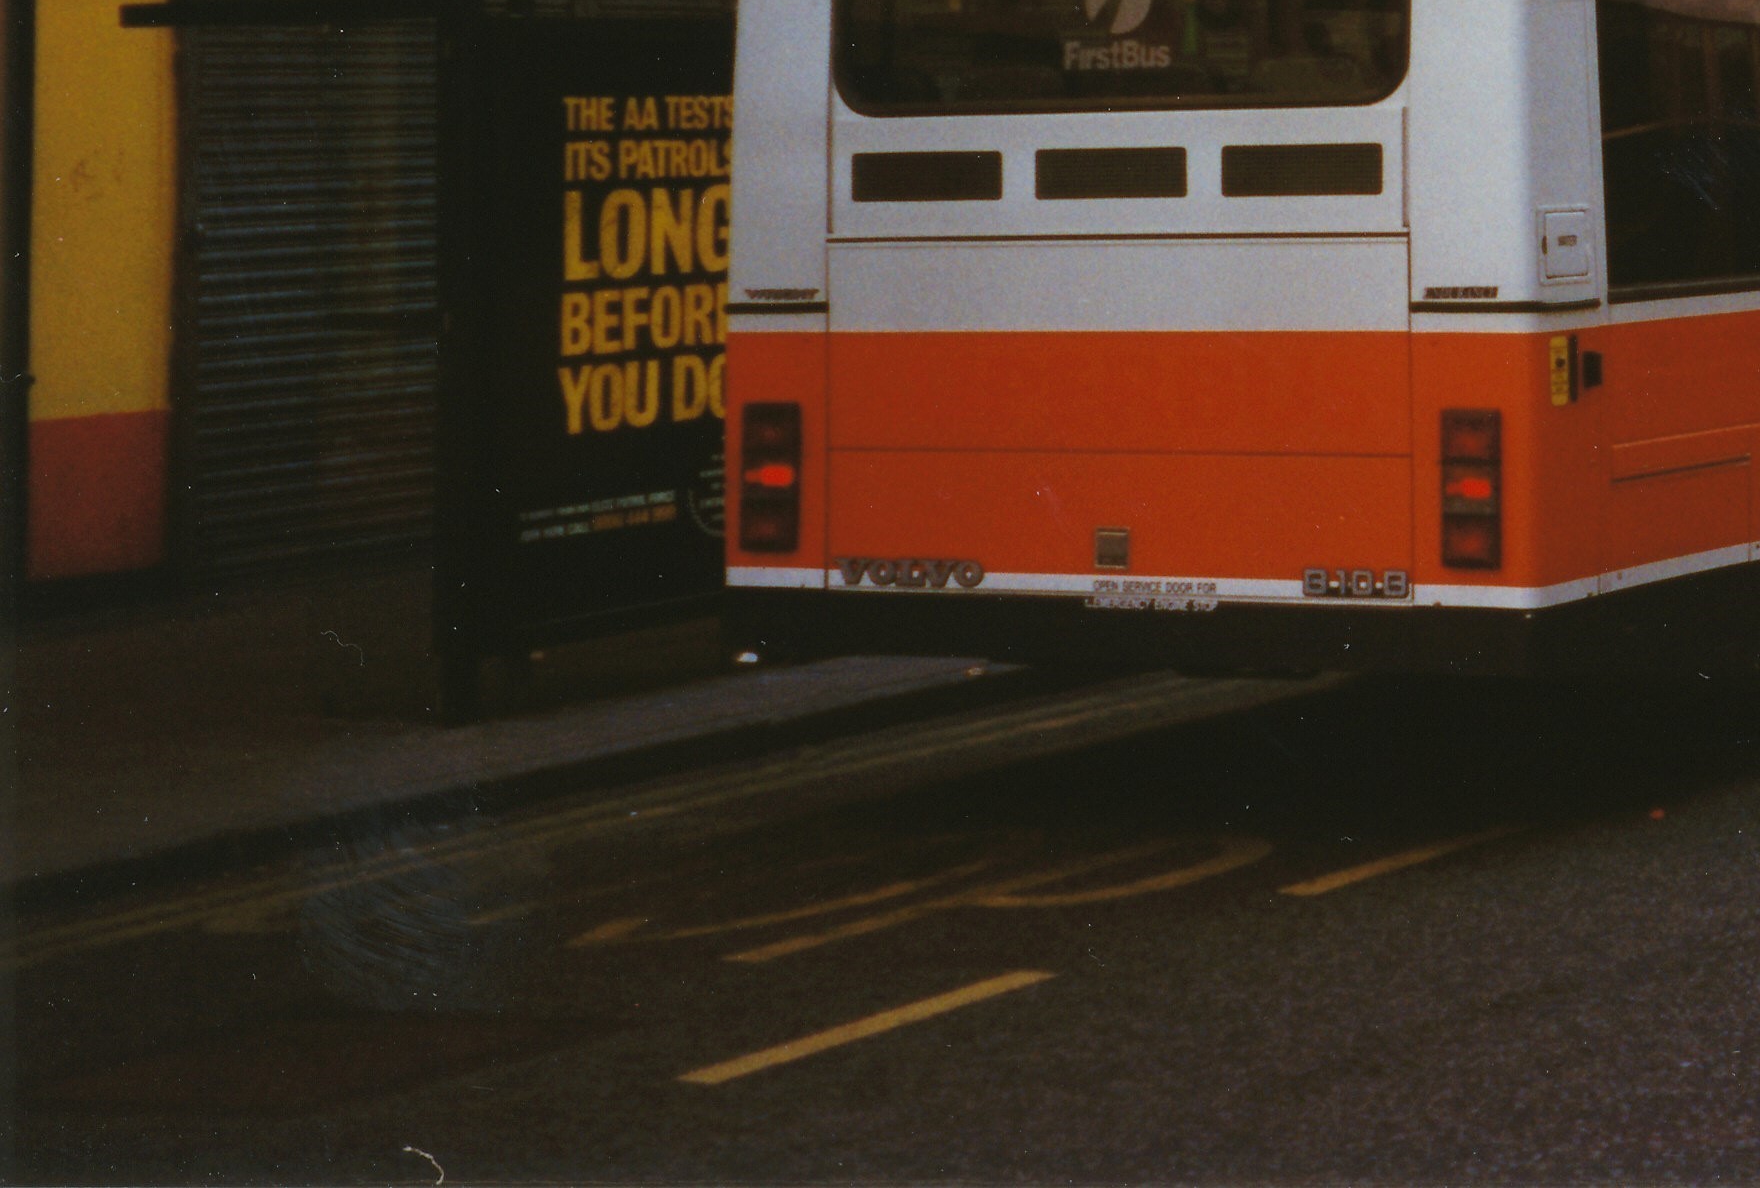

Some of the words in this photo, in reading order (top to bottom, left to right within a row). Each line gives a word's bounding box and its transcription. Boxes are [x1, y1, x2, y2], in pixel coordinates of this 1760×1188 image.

[1063, 39, 1171, 70] FirstBus
[564, 96, 615, 132] THE
[623, 96, 659, 131] AA
[565, 141, 611, 181] ITS
[558, 358, 660, 435] YOU
[835, 557, 985, 588] VOLVO
[1093, 579, 1119, 593] OPEN
[1123, 580, 1162, 594] SERVICE
[1165, 581, 1193, 594] DOOR
[1197, 582, 1217, 594] FOR
